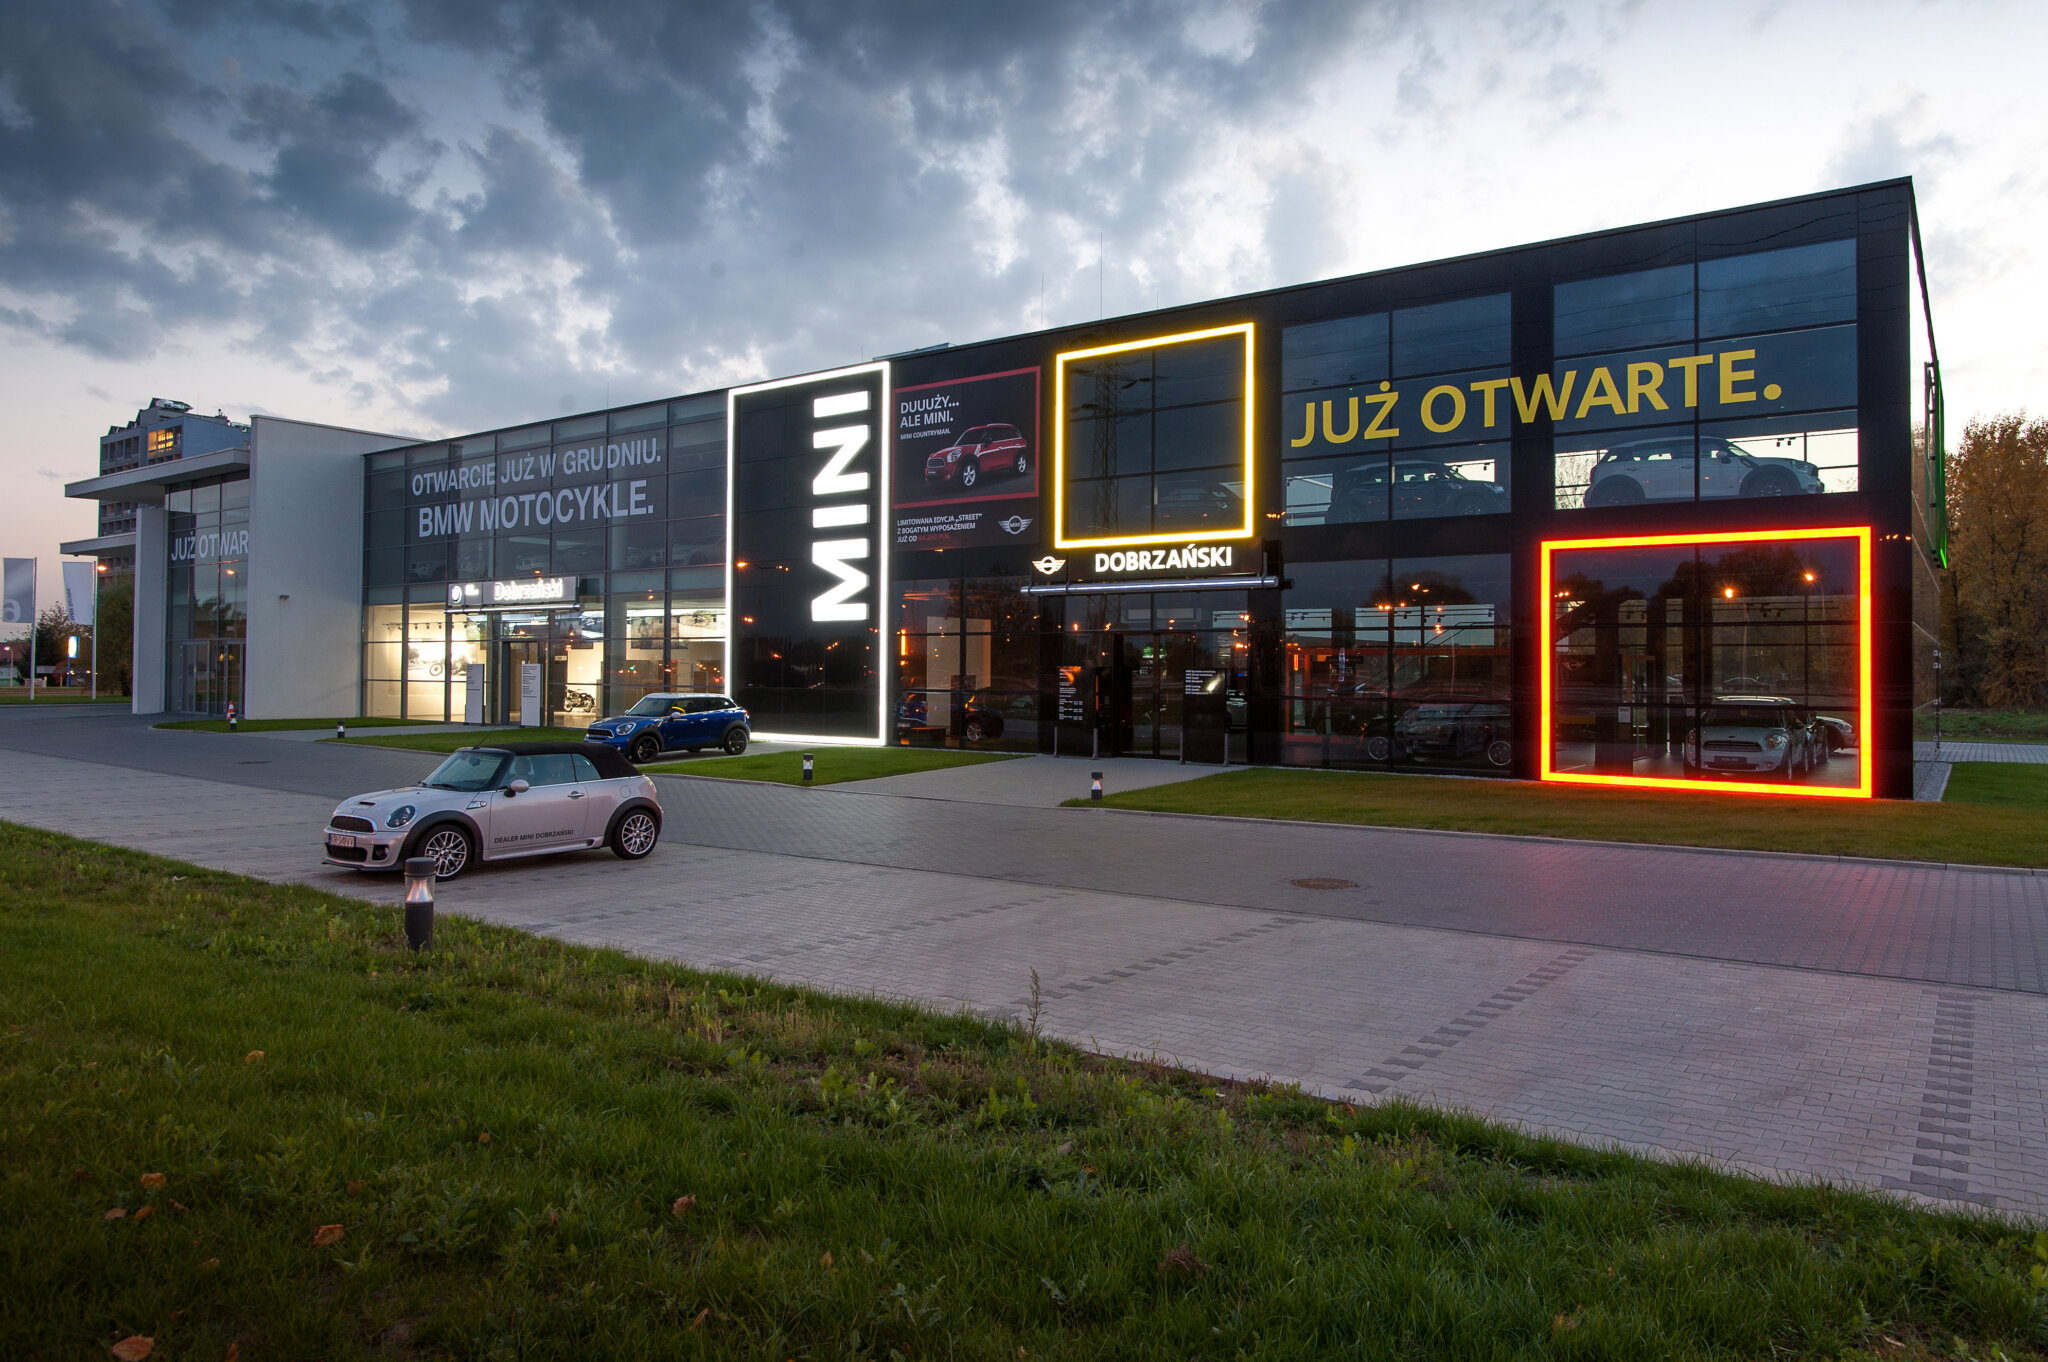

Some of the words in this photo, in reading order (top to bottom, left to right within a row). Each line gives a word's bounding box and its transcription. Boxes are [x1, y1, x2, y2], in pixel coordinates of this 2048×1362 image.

[900, 394, 960, 414] DUUUŻY...
[1291, 380, 1400, 448] JUŻ
[1420, 349, 1782, 434] OTWARTE.
[900, 414, 921, 428] ALE
[923, 410, 954, 425] MINI.
[912, 428, 951, 439] COUNTRYMAN.
[412, 462, 496, 496] OTWARCIE
[500, 452, 535, 484] JUŻ
[539, 452, 557, 478] W
[562, 437, 661, 475] GRUDNIU.
[418, 501, 474, 538] BMW
[480, 479, 654, 531] MOTOCYKLE.
[811, 390, 871, 622] MINI
[897, 517, 933, 527] LIMITOWANA
[933, 515, 955, 524] EDYCJA
[902, 526, 929, 534] BOGATYM
[930, 522, 976, 532] WYPOSAŻENIEM
[171, 531, 196, 561] JUŻ
[198, 530, 249, 558] OTWAR
[896, 535, 908, 543] JUŻ
[1095, 543, 1232, 572] DOBRZAŃSKI
[494, 835, 518, 844] DEALER
[535, 829, 574, 839] DOBRZAŃSKI
